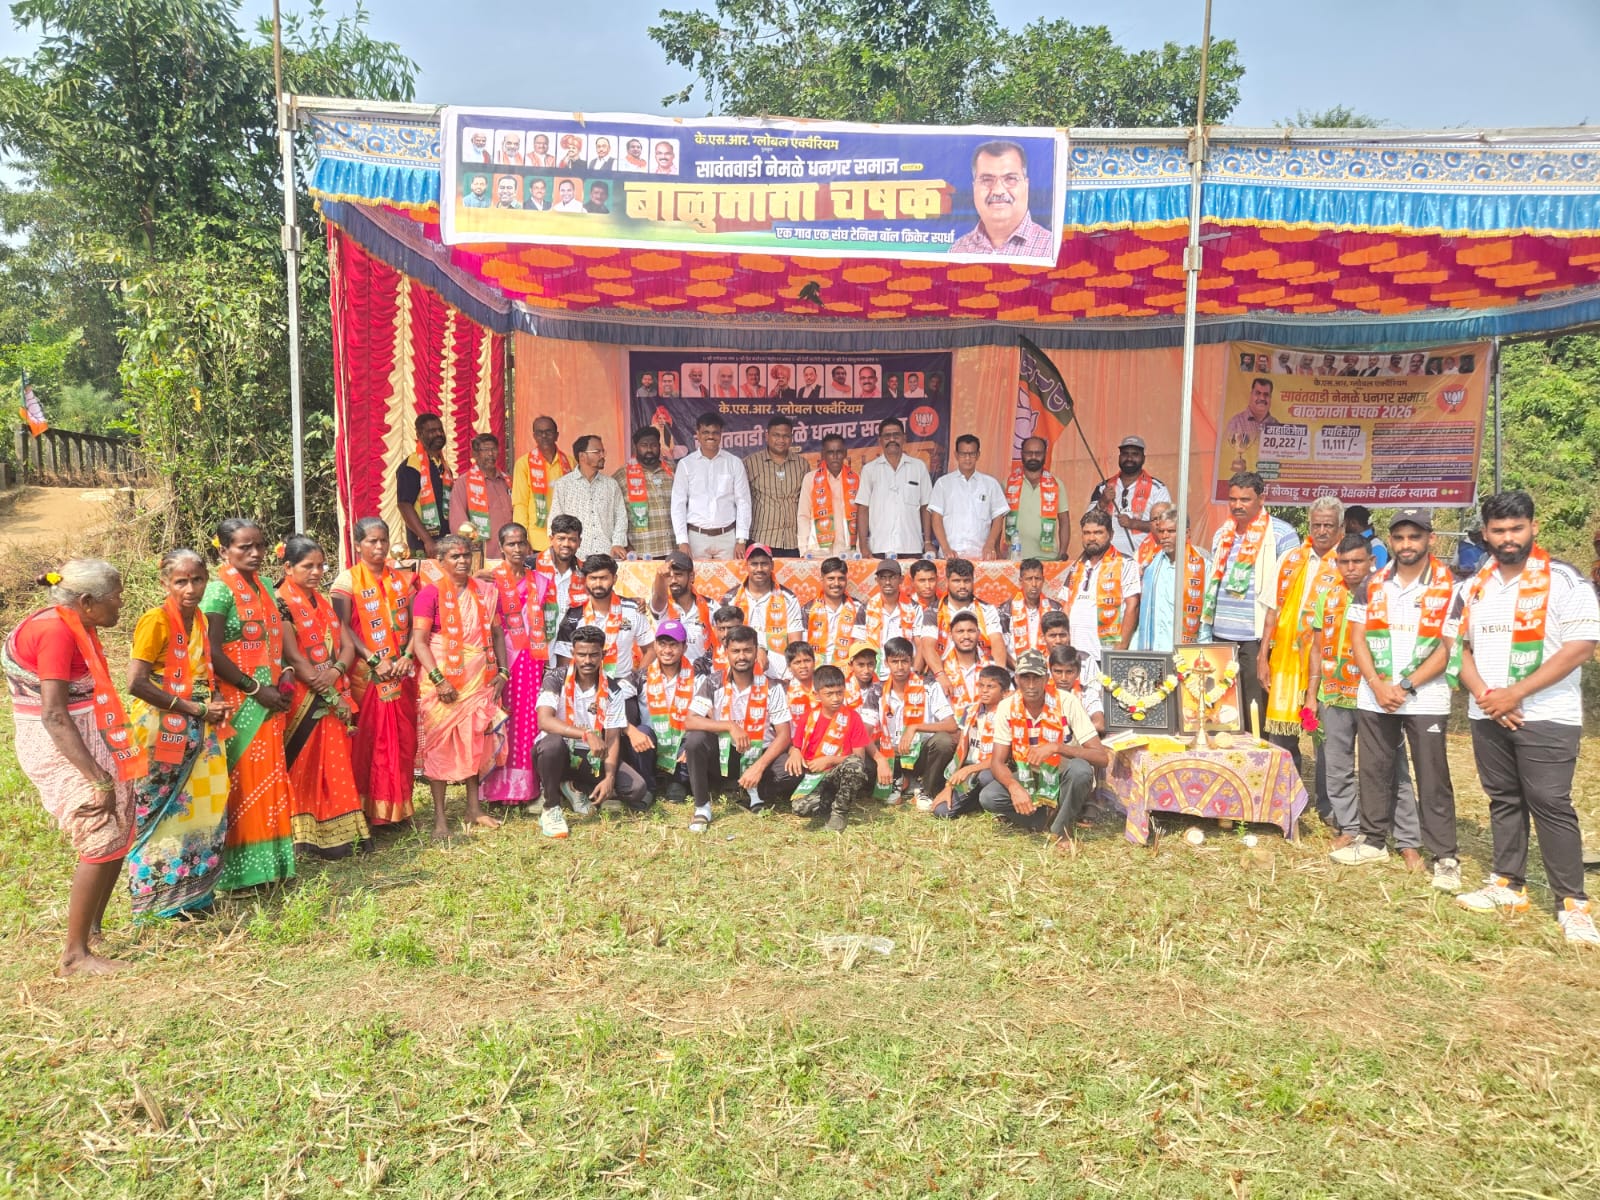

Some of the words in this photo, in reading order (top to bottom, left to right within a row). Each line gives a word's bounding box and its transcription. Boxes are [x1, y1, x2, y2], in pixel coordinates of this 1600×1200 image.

[695, 155, 763, 178] सावंतवाडी
[764, 155, 805, 178] नेमळे
[807, 159, 852, 177] धनगर
[853, 157, 900, 175] समाज
[830, 179, 947, 221] चषक
[776, 227, 792, 239] एक
[814, 229, 829, 240] एक
[831, 227, 849, 241] संघ
[850, 227, 877, 241] टेनिस
[879, 228, 900, 242] बॉल
[901, 229, 929, 243] क्रिकेट
[931, 229, 955, 244] स्पर्धा
[1280, 388, 1329, 403] सावंतवाडी
[1362, 392, 1395, 403] धनगर
[719, 402, 775, 415] के.एस.आर.
[777, 401, 813, 415] ग्लोबल
[1381, 404, 1413, 418] 2026
[1263, 437, 1296, 449] 20,222
[1322, 439, 1345, 450] 11,111
[1408, 488, 1438, 498] स्वागत
[105, 712, 115, 725] P
[161, 732, 184, 744] BJP
[117, 746, 140, 760] BJP
